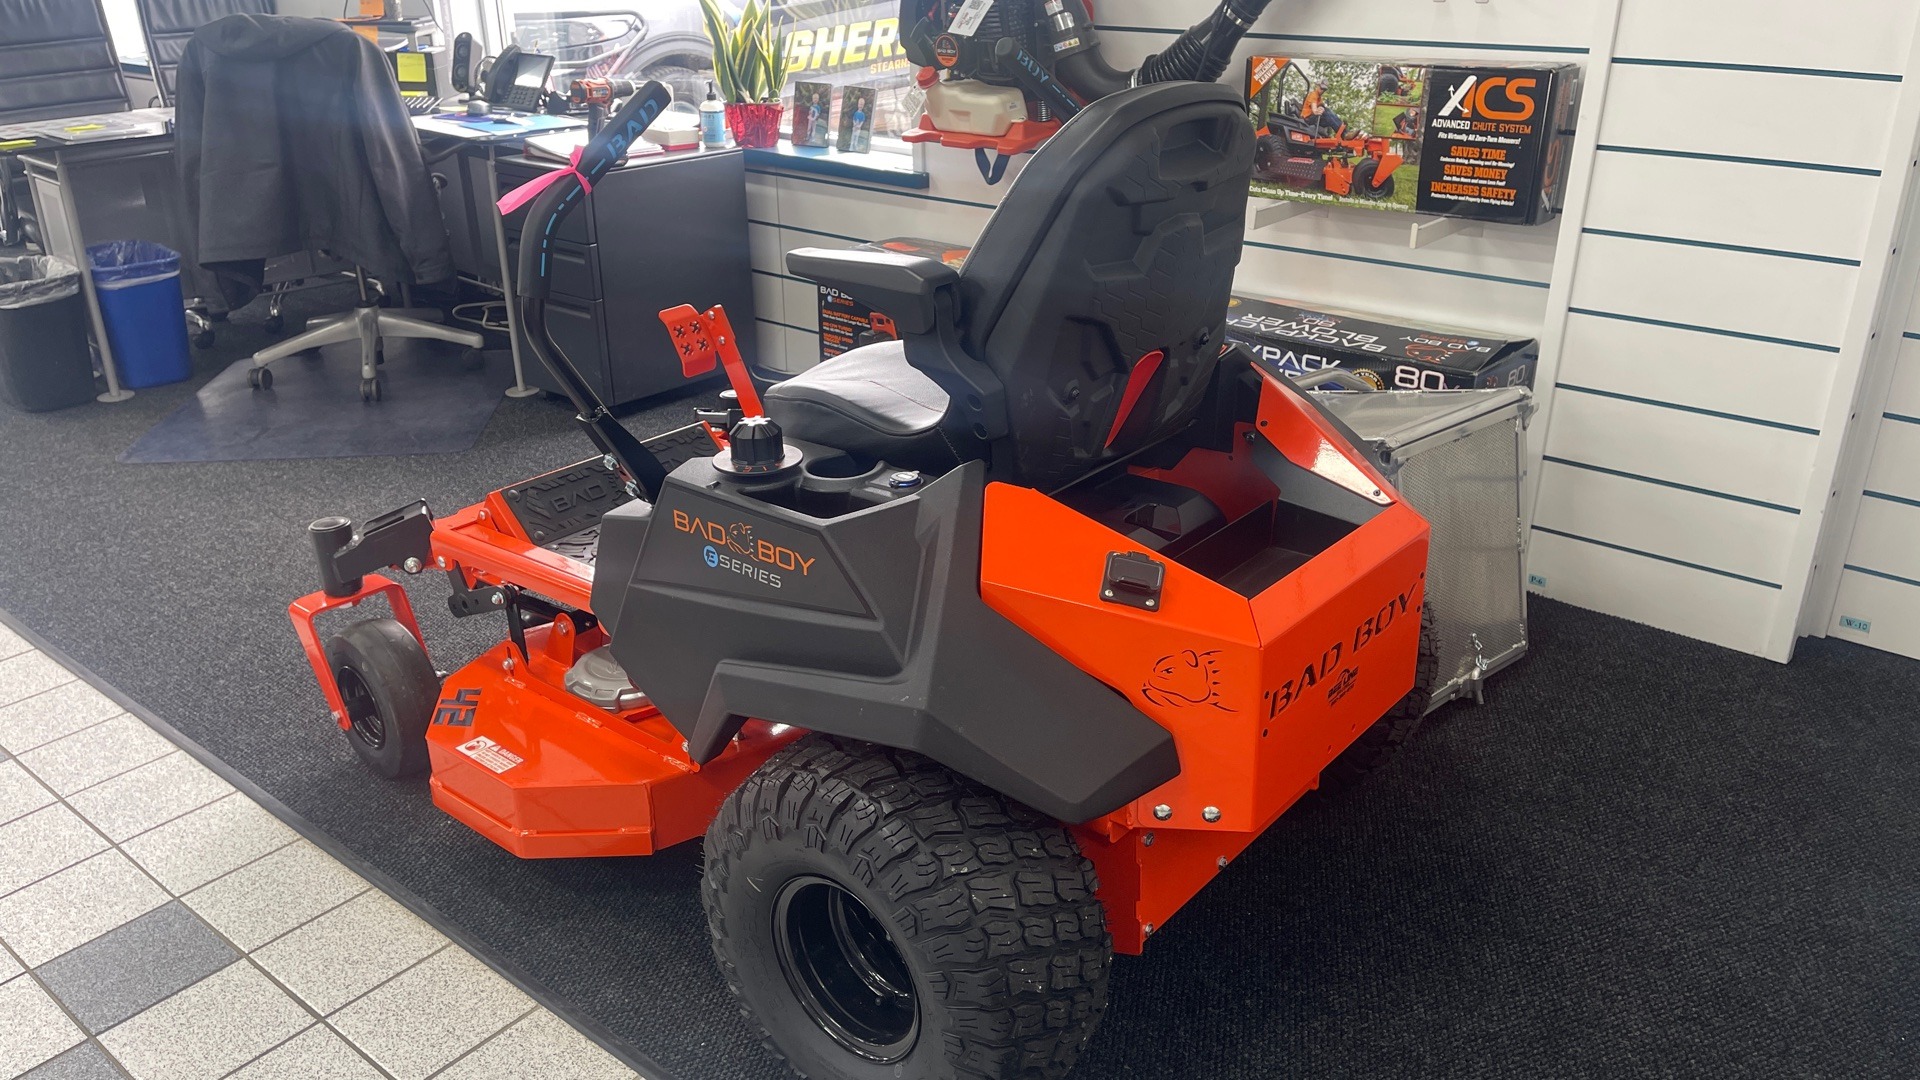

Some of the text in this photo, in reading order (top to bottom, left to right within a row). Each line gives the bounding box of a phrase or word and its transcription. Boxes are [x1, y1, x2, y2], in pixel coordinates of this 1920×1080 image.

[1016, 49, 1049, 83] BOY
[1438, 74, 1536, 121] ACS
[606, 98, 658, 158] BAD
[1432, 118, 1531, 134] ADVANCED CHUTE SYSTEM
[1438, 131, 1448, 139] Fits
[1448, 132, 1468, 142] Virtually
[1475, 134, 1498, 143] Zero-Turn
[1451, 146, 1506, 160] SAVES TIME
[1444, 164, 1508, 179] SAVES MONEY
[1277, 188, 1284, 196] Up
[1431, 181, 1516, 199] INCREASES SAFETY
[820, 286, 838, 296] BAD
[832, 298, 854, 306] SERIES
[1242, 313, 1379, 343] BLOWER
[1399, 336, 1491, 353] BAD BOY
[552, 484, 606, 512] BAD
[673, 509, 816, 576] BAD BOY
[719, 554, 782, 588] SERIES
[1268, 582, 1418, 721] BAD BOY
[433, 688, 482, 726] 42
